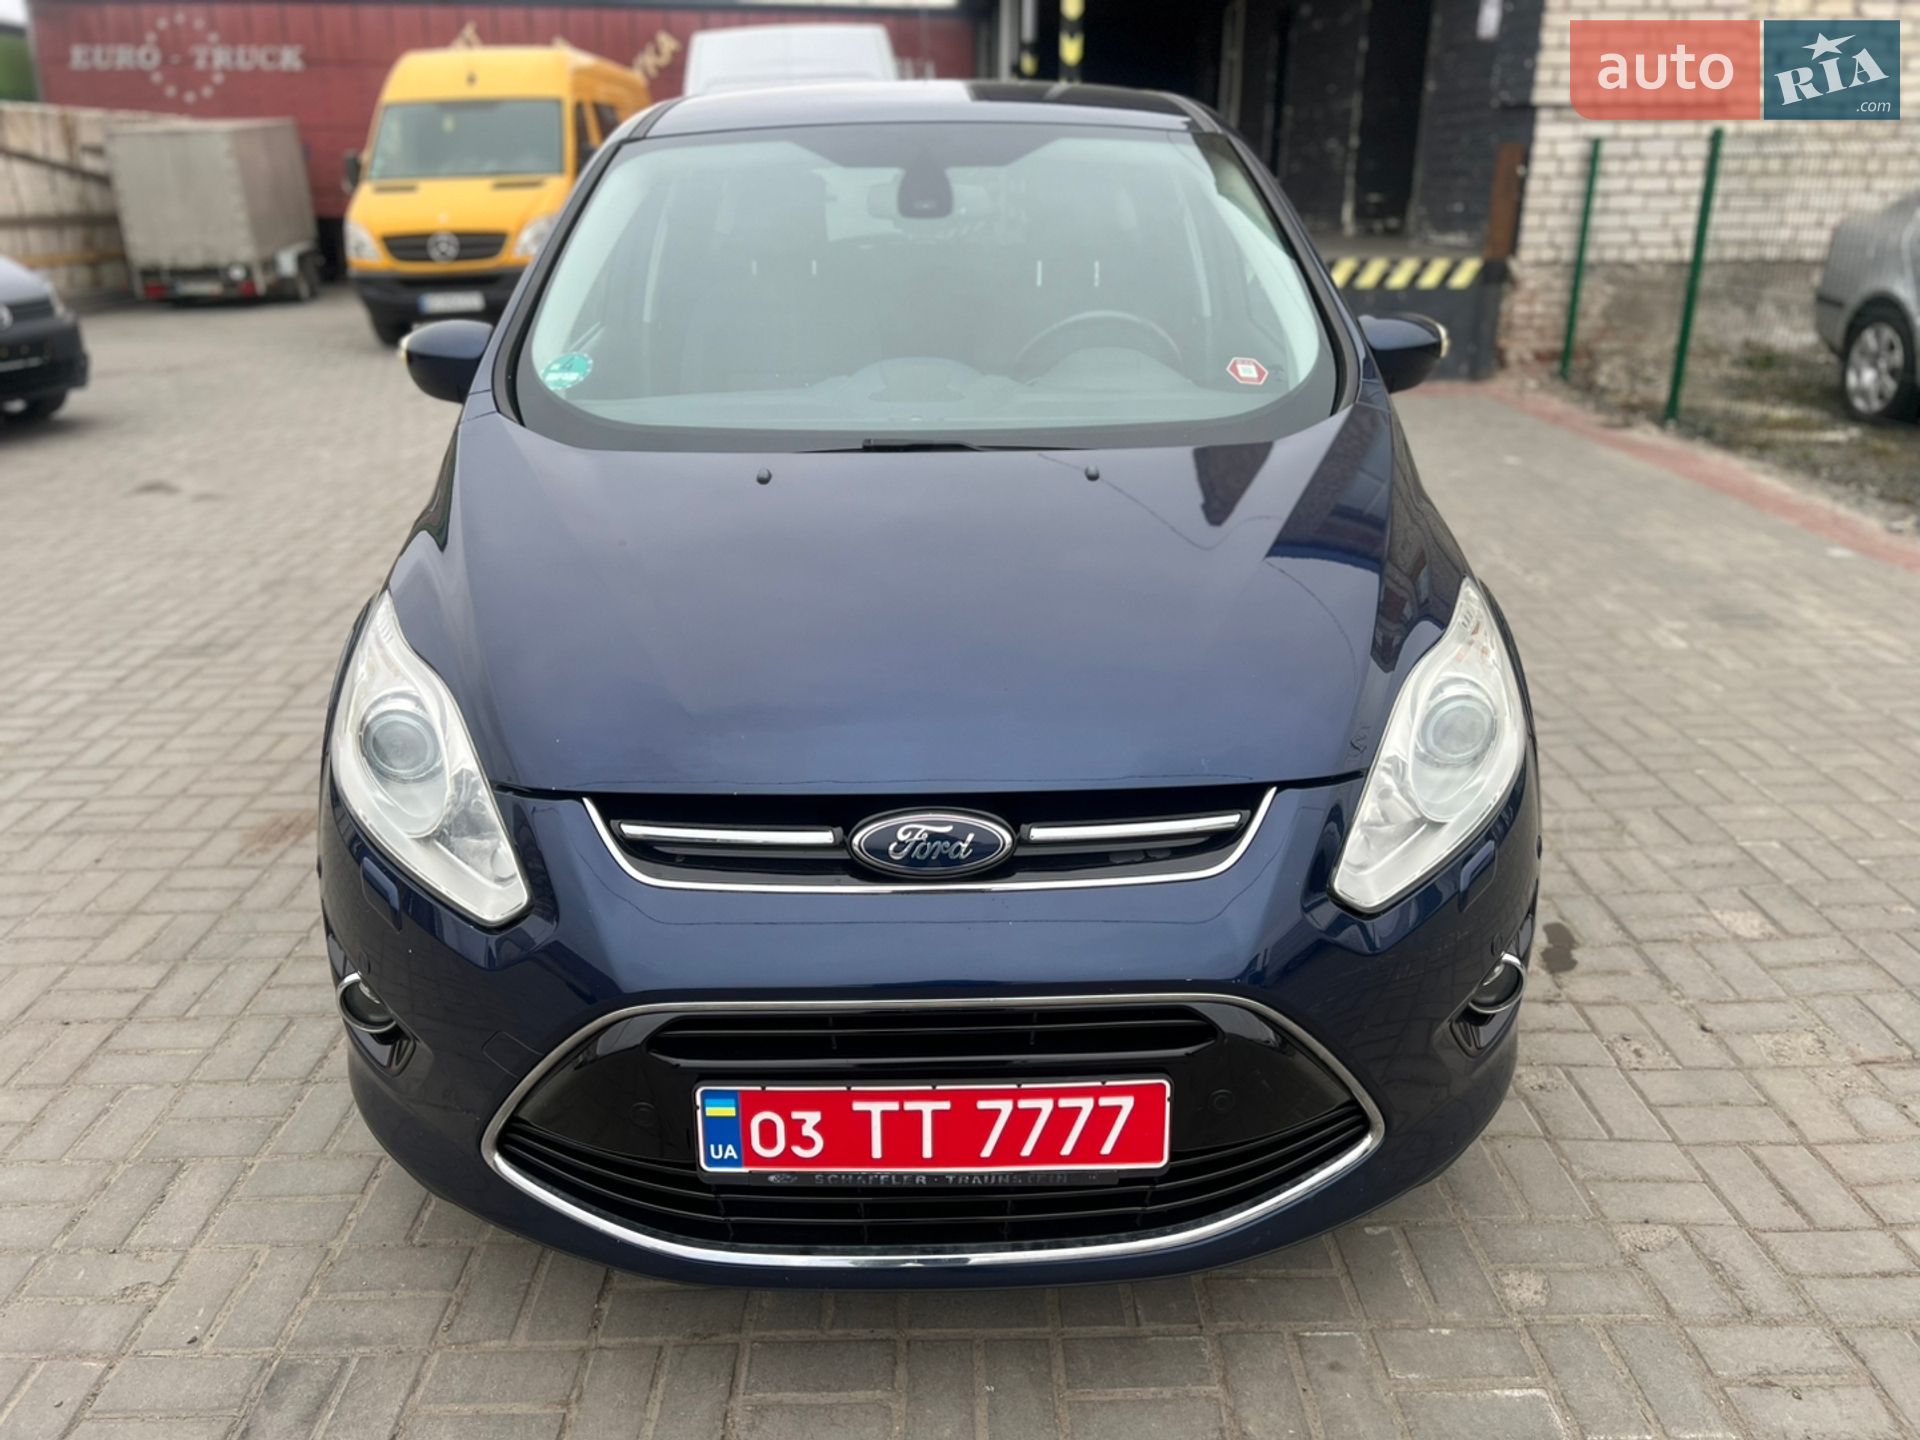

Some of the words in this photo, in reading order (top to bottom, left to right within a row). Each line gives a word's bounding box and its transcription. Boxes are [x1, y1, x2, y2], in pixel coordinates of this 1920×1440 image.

[70, 44, 161, 72] EURO
[191, 44, 304, 72] TRUCK
[888, 823, 976, 860] Ford
[750, 1110, 825, 1158] 03
[852, 1100, 952, 1159] TT
[976, 1096, 1135, 1158] 7777
[709, 1143, 738, 1160] UA
